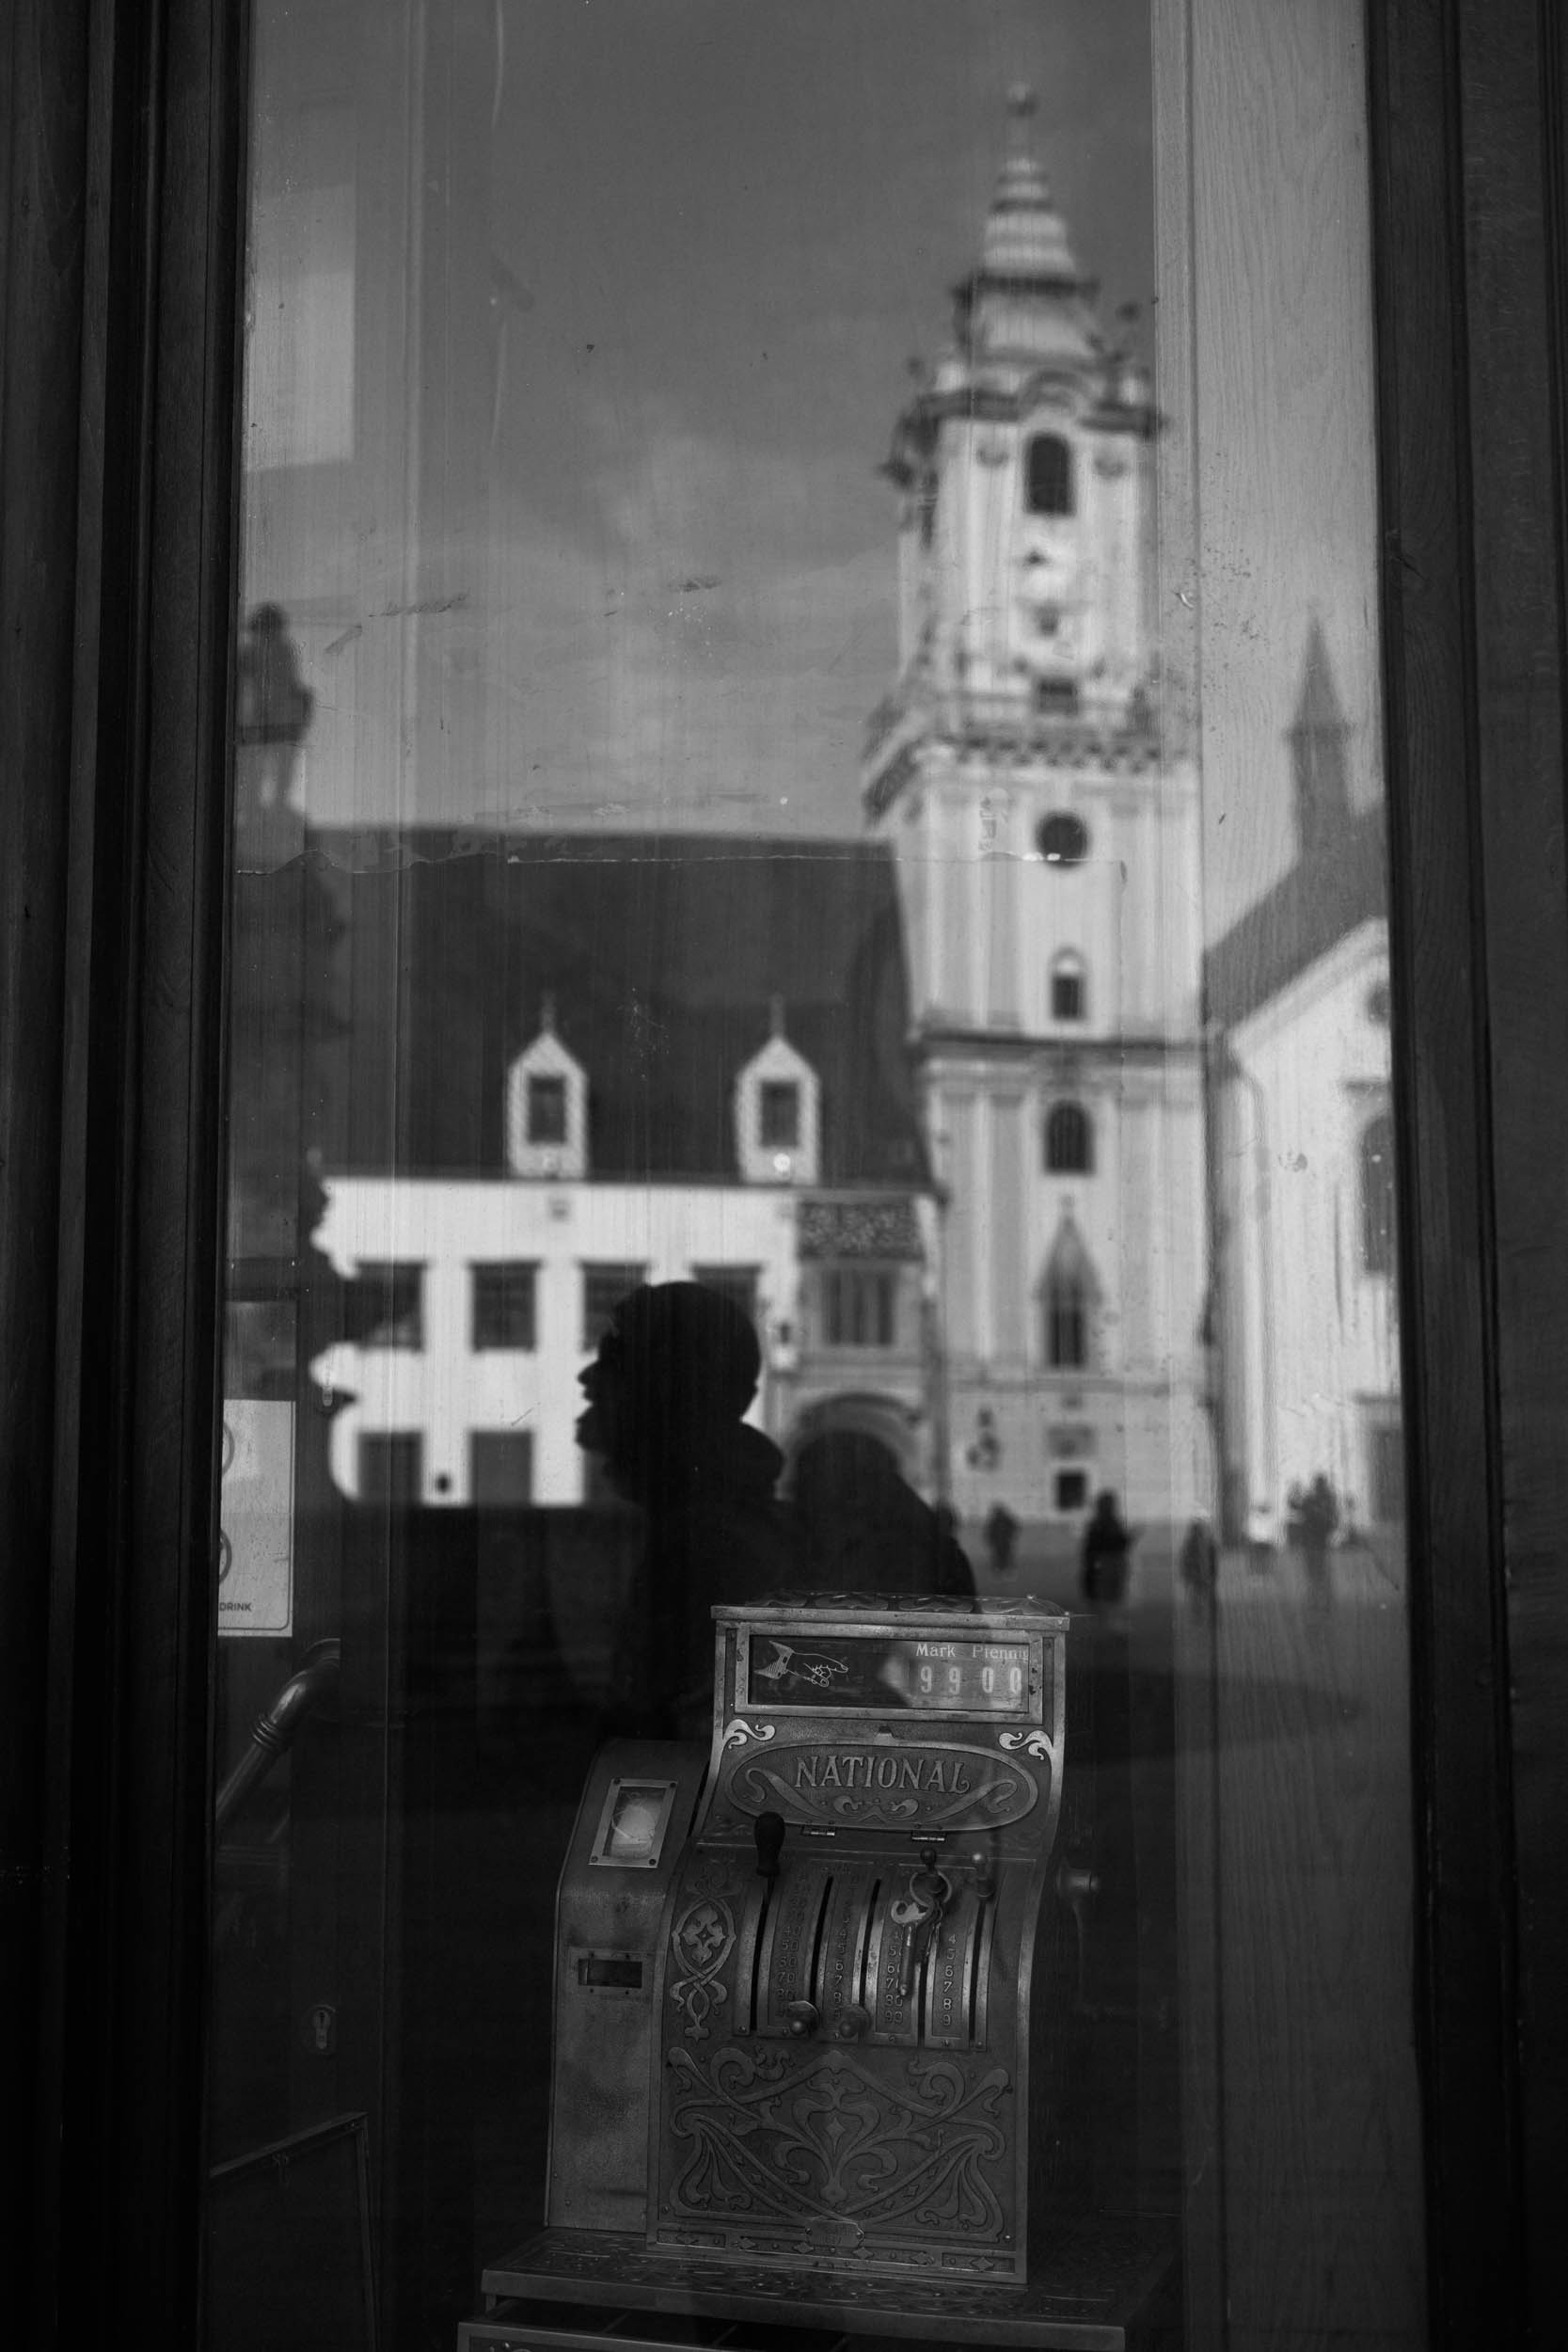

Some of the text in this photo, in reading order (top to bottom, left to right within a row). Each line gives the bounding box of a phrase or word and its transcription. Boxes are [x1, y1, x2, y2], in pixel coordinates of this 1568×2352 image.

[219, 1602, 251, 1612] DRINK
[915, 1642, 957, 1658] Mark
[794, 1756, 971, 1795] NATIONAL
[834, 1958, 844, 1972] 6
[944, 1964, 954, 1978] 6
[833, 1974, 844, 1987] 7
[943, 1980, 953, 1993] 7
[833, 1990, 843, 2003] 8
[942, 1997, 953, 2010] 8
[942, 2013, 952, 2026] 9
